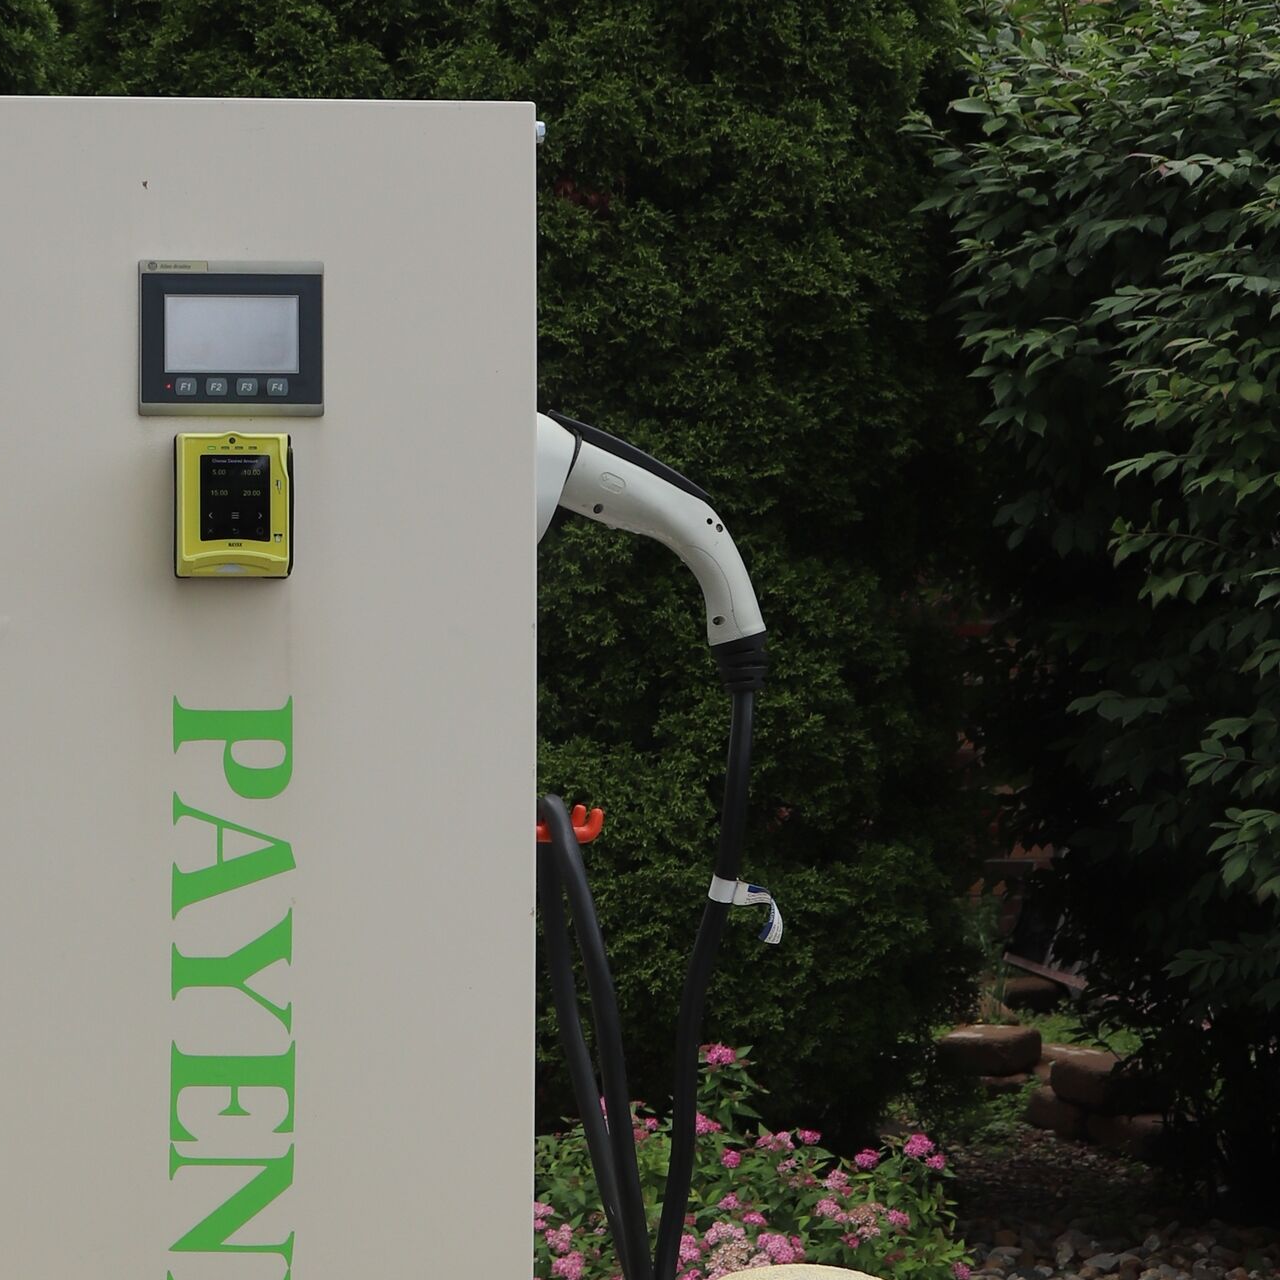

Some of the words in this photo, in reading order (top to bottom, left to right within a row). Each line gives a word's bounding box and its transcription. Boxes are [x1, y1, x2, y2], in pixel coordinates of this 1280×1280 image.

[180, 382, 192, 391] F1
[210, 382, 223, 392] F2
[241, 382, 253, 392] F3
[271, 382, 283, 392] F4
